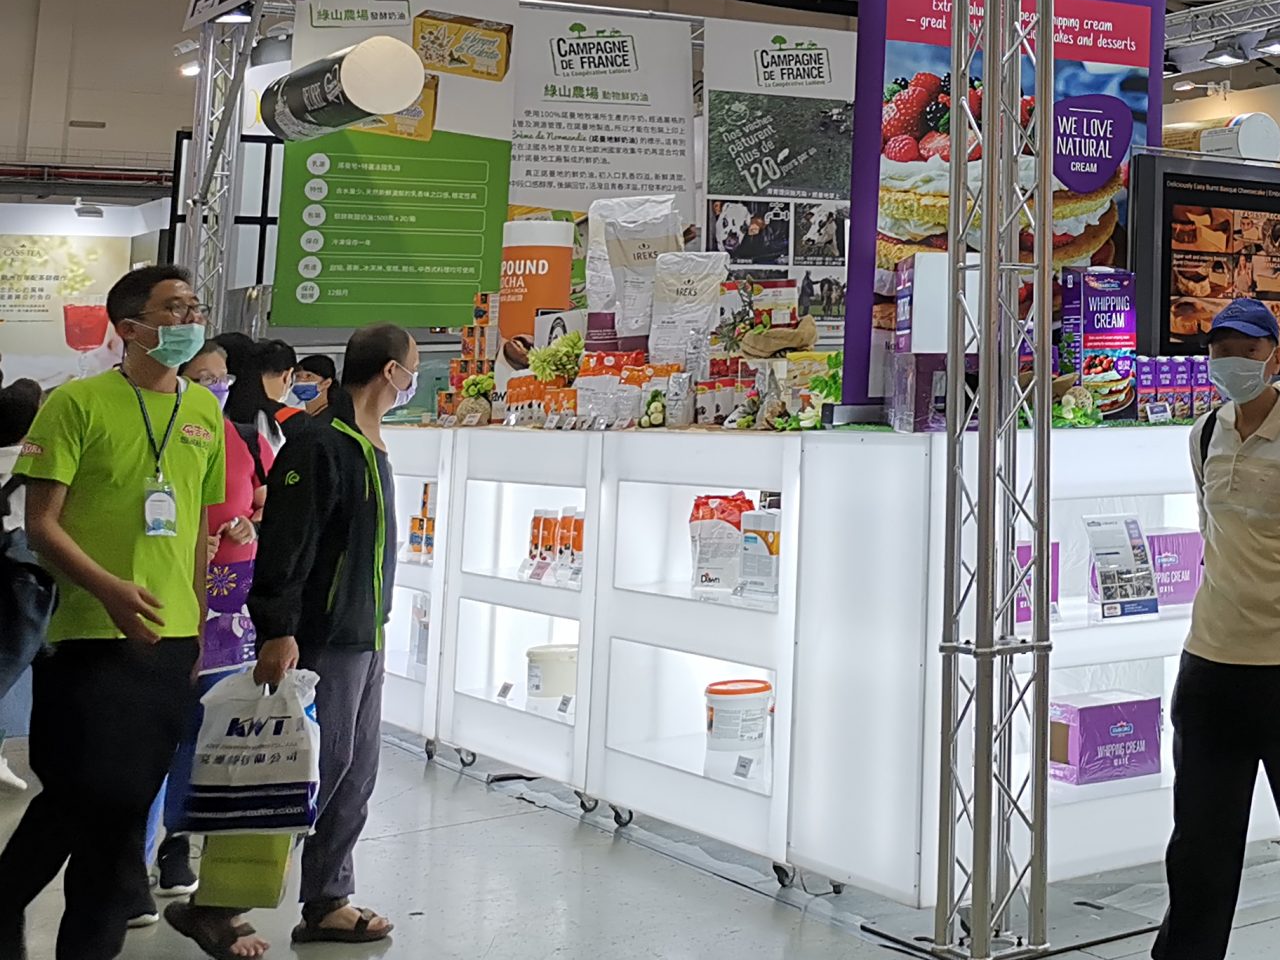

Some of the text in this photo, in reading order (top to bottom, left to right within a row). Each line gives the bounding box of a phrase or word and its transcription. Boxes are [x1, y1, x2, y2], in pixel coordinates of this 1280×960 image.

[317, 8, 369, 22] 綠山農場
[1052, 16, 1080, 32] hipping
[1083, 19, 1113, 31] cream
[920, 16, 1136, 52] great akes and desserts
[556, 37, 629, 58] CAMPAGNE
[560, 55, 631, 70] DE FRANCE
[760, 49, 824, 68] CAMPAGNE
[763, 65, 825, 81] DE FRANCE
[543, 84, 599, 101] 綠山農場
[722, 115, 773, 143] Nos vaches
[1057, 116, 1114, 138] WE LOVE
[728, 125, 777, 159] pâturent
[1056, 138, 1113, 159] NATURAL
[735, 139, 776, 172] plus de
[740, 156, 781, 194] 120
[1070, 161, 1098, 173] CREAM
[633, 250, 658, 261] IREKS
[501, 259, 549, 275] POUND
[676, 287, 698, 297] IREKS
[1088, 296, 1130, 312] WHIPPING
[1094, 312, 1125, 329] CREAM
[1170, 569, 1191, 582] CREAM
[225, 715, 292, 738] KWT
[1097, 739, 1146, 758] WHIPPING CREAM
